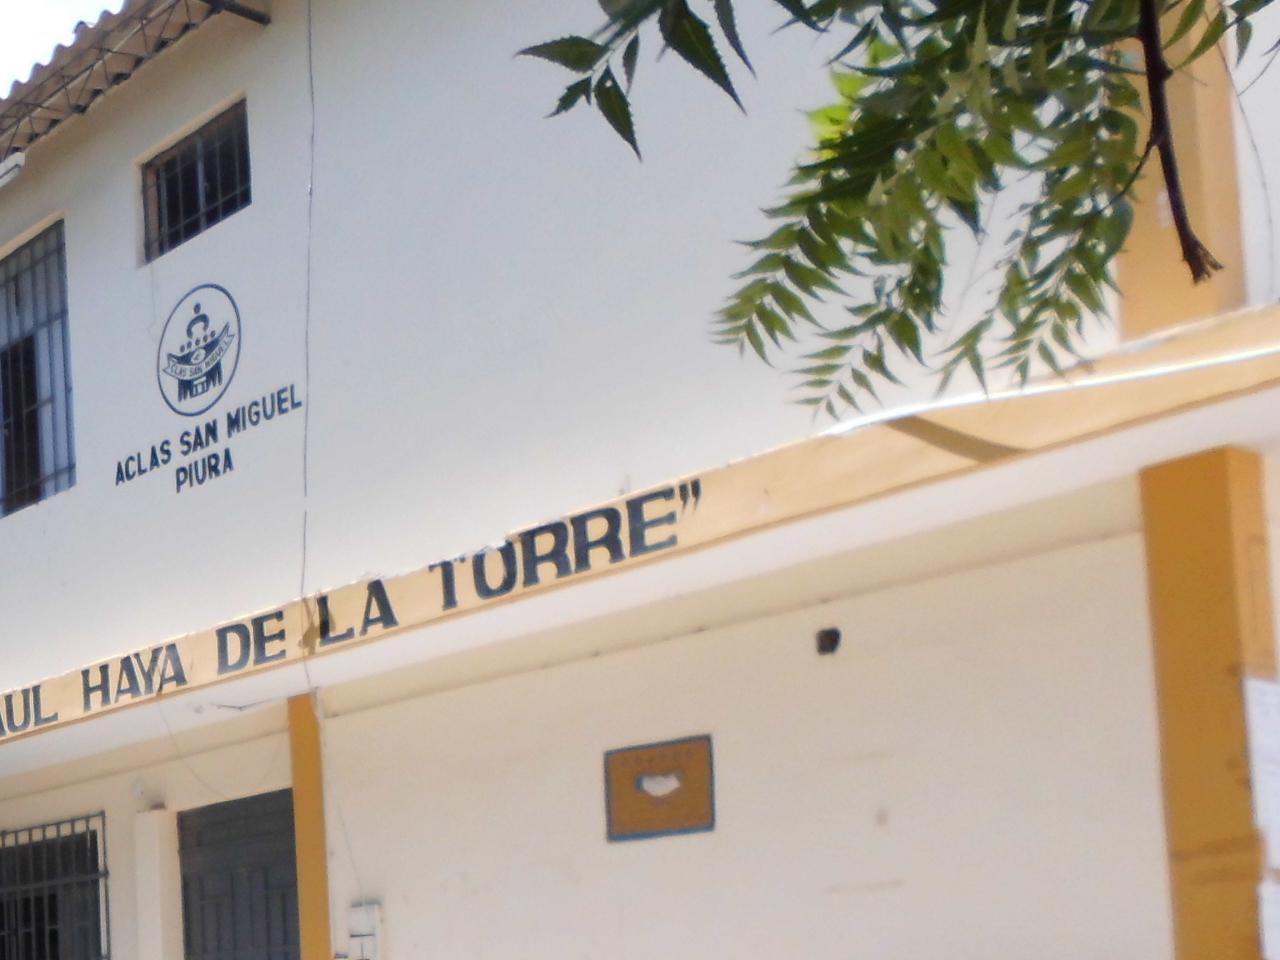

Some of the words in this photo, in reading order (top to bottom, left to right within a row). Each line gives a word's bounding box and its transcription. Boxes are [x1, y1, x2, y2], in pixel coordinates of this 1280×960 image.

[115, 439, 172, 486] ACLAS
[179, 418, 219, 457] SAN
[226, 383, 303, 439] MIGUEL
[175, 447, 234, 494] PIURA
[80, 642, 189, 713] HAYA
[214, 609, 288, 676] DE
[316, 578, 400, 648] LA
[427, 477, 703, 612] TORRE"
